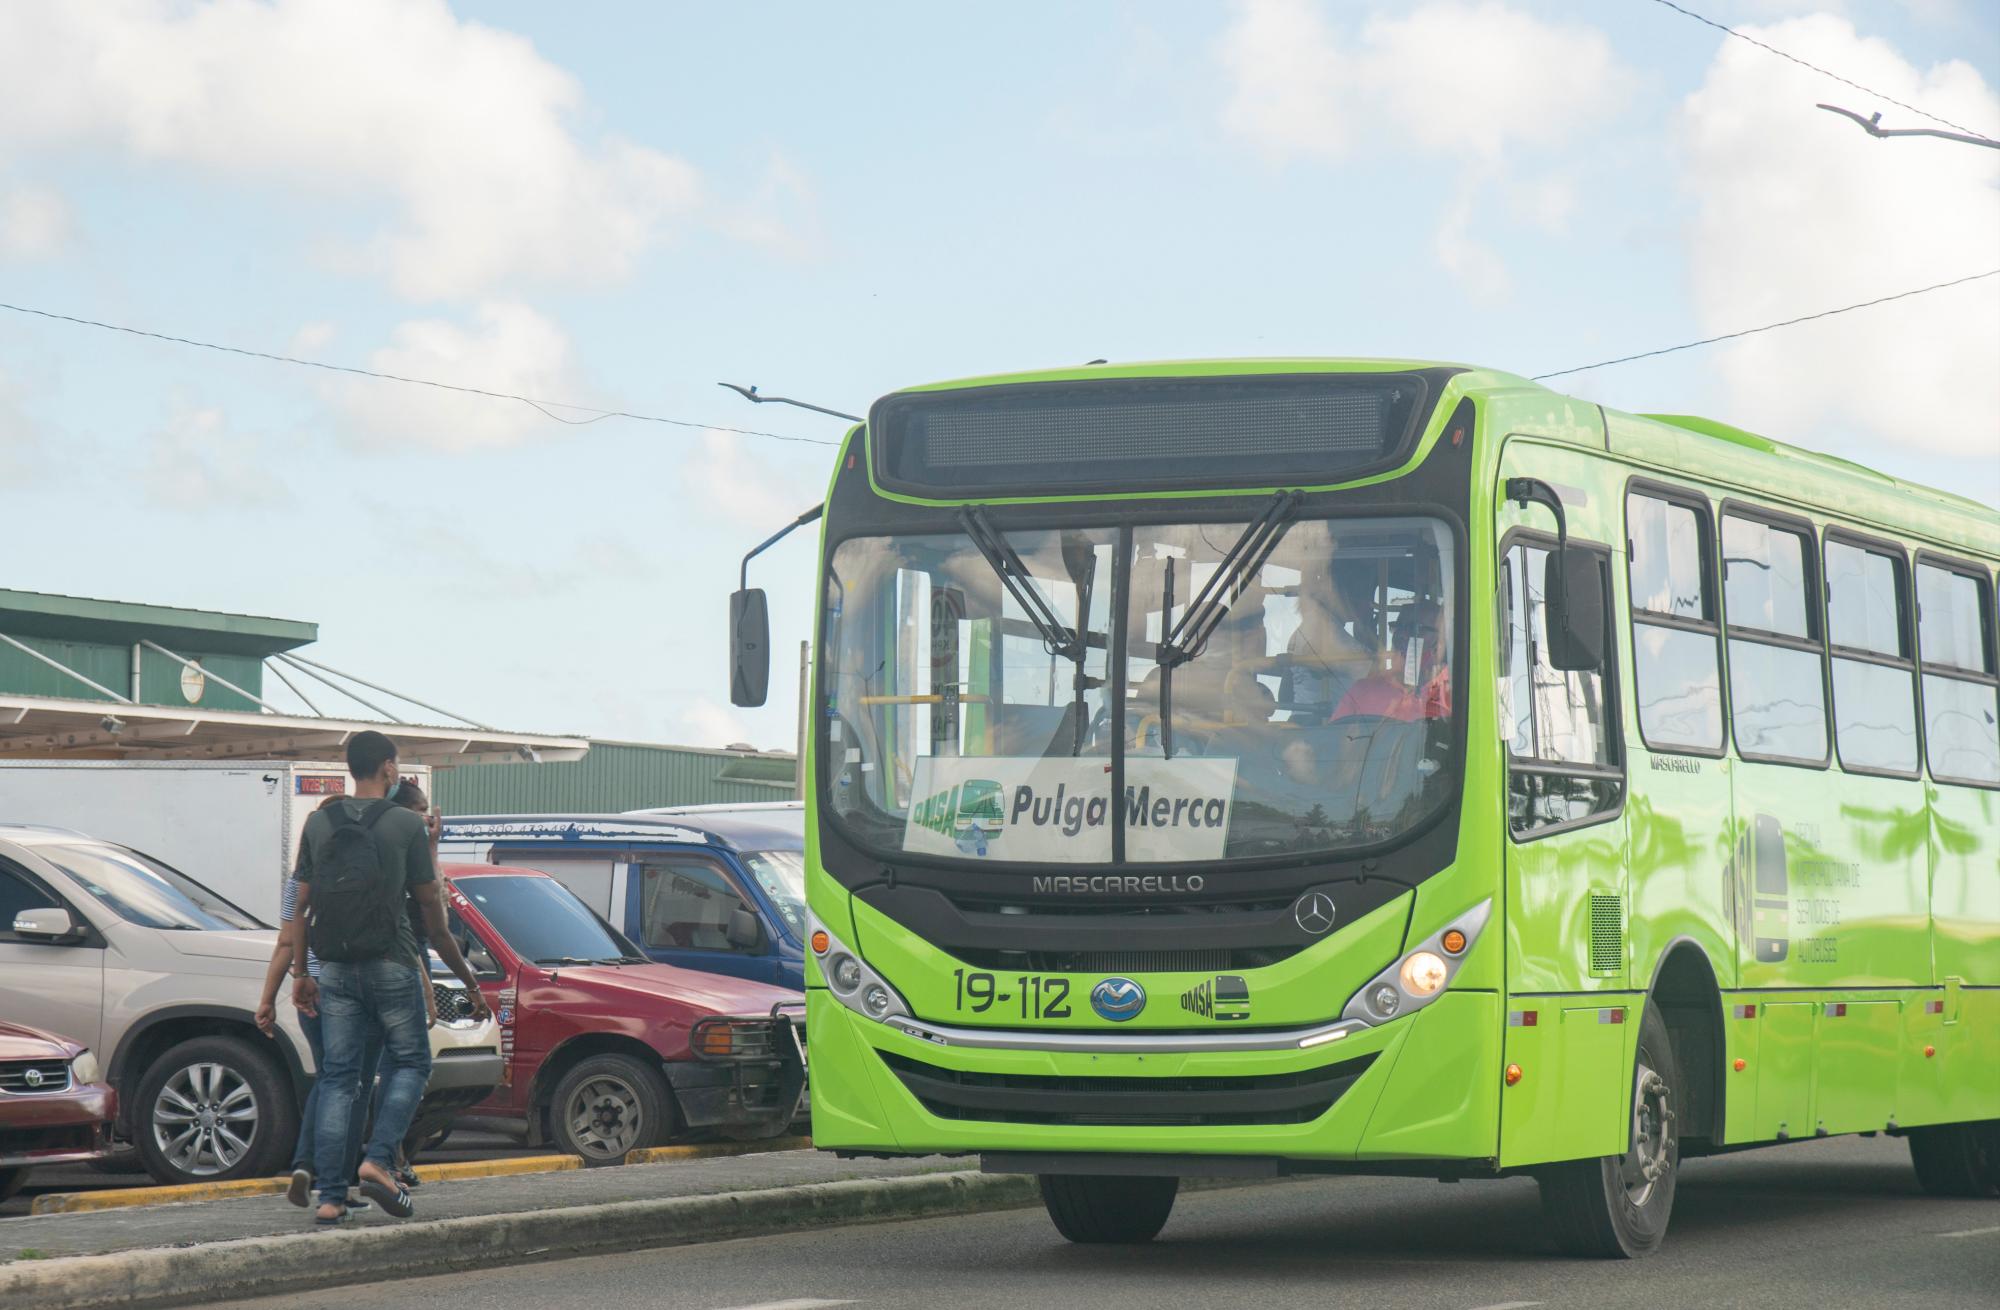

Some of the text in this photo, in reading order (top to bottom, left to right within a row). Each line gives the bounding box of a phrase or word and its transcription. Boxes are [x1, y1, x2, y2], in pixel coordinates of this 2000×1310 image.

[912, 784, 959, 838] OMSA
[1010, 783, 1225, 837] Pulga Merca
[1032, 875, 1204, 894] MASCARELLO
[954, 968, 1072, 1019] 19-112
[1181, 979, 1214, 1019] OMSA
